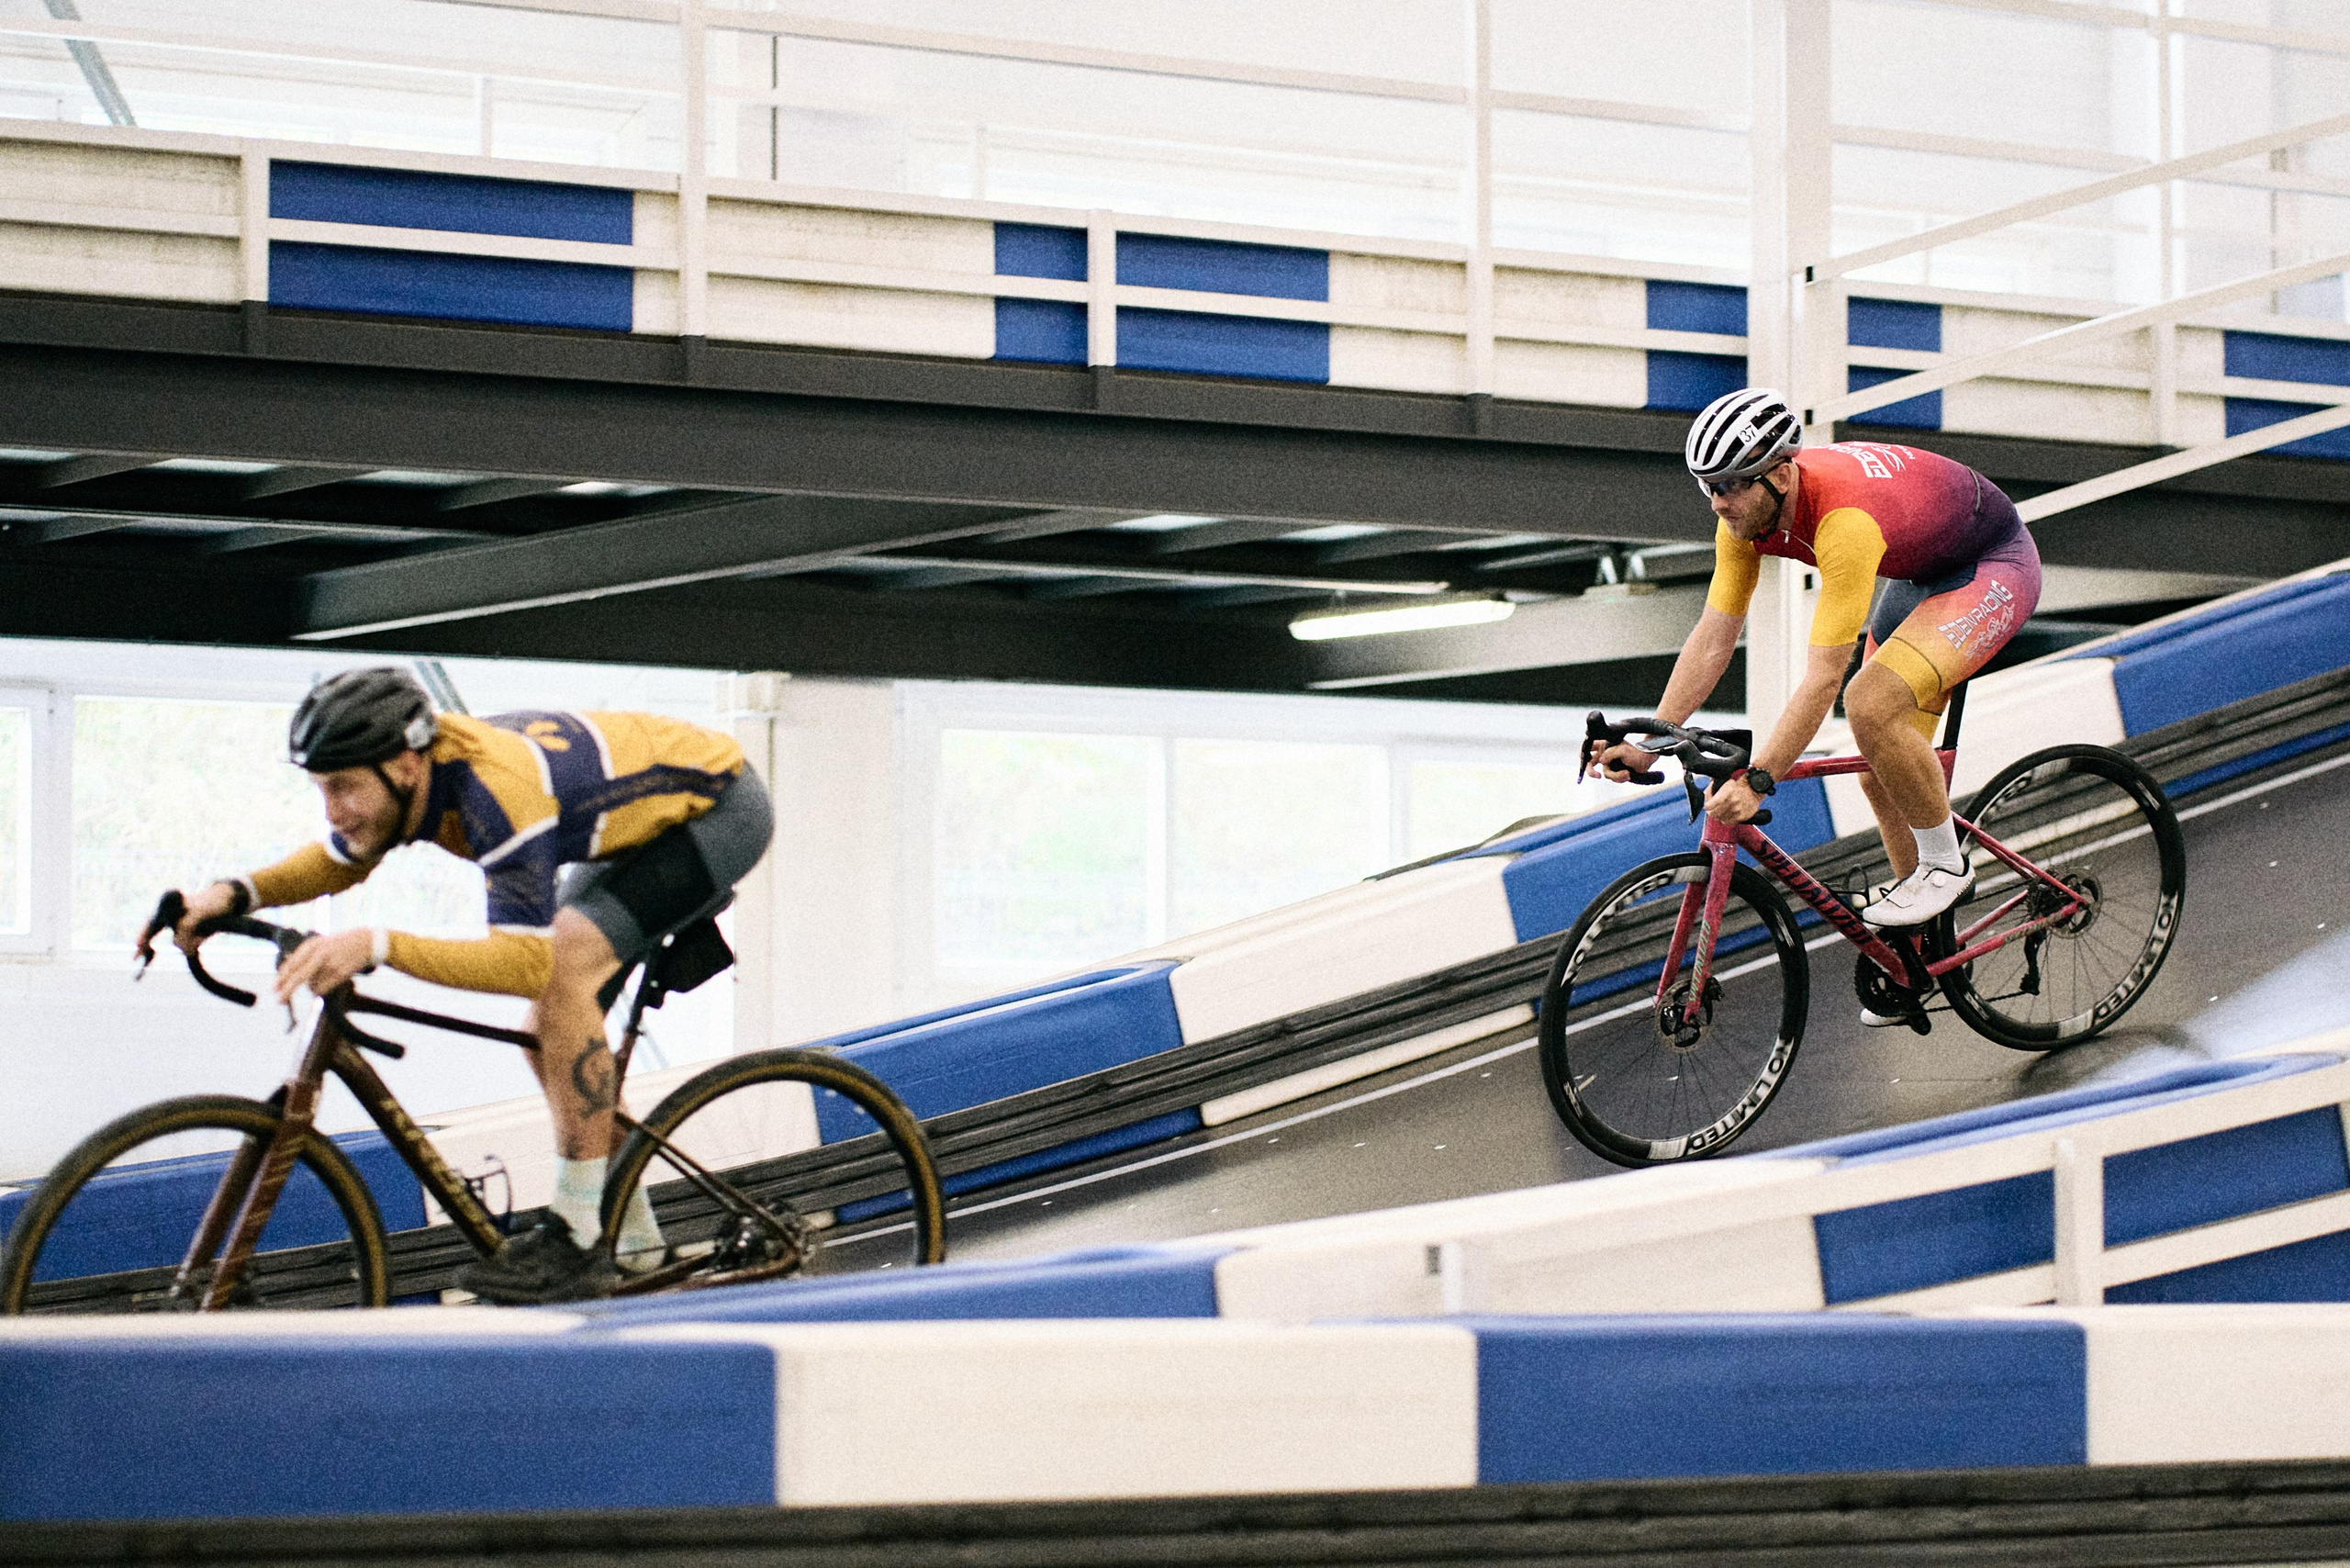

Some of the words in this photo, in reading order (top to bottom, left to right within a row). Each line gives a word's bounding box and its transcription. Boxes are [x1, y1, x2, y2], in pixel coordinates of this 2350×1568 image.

[1740, 424, 1757, 442] 37
[1754, 839, 1874, 946] SPECIALIZED
[1688, 1079, 1772, 1150] LIMITED
